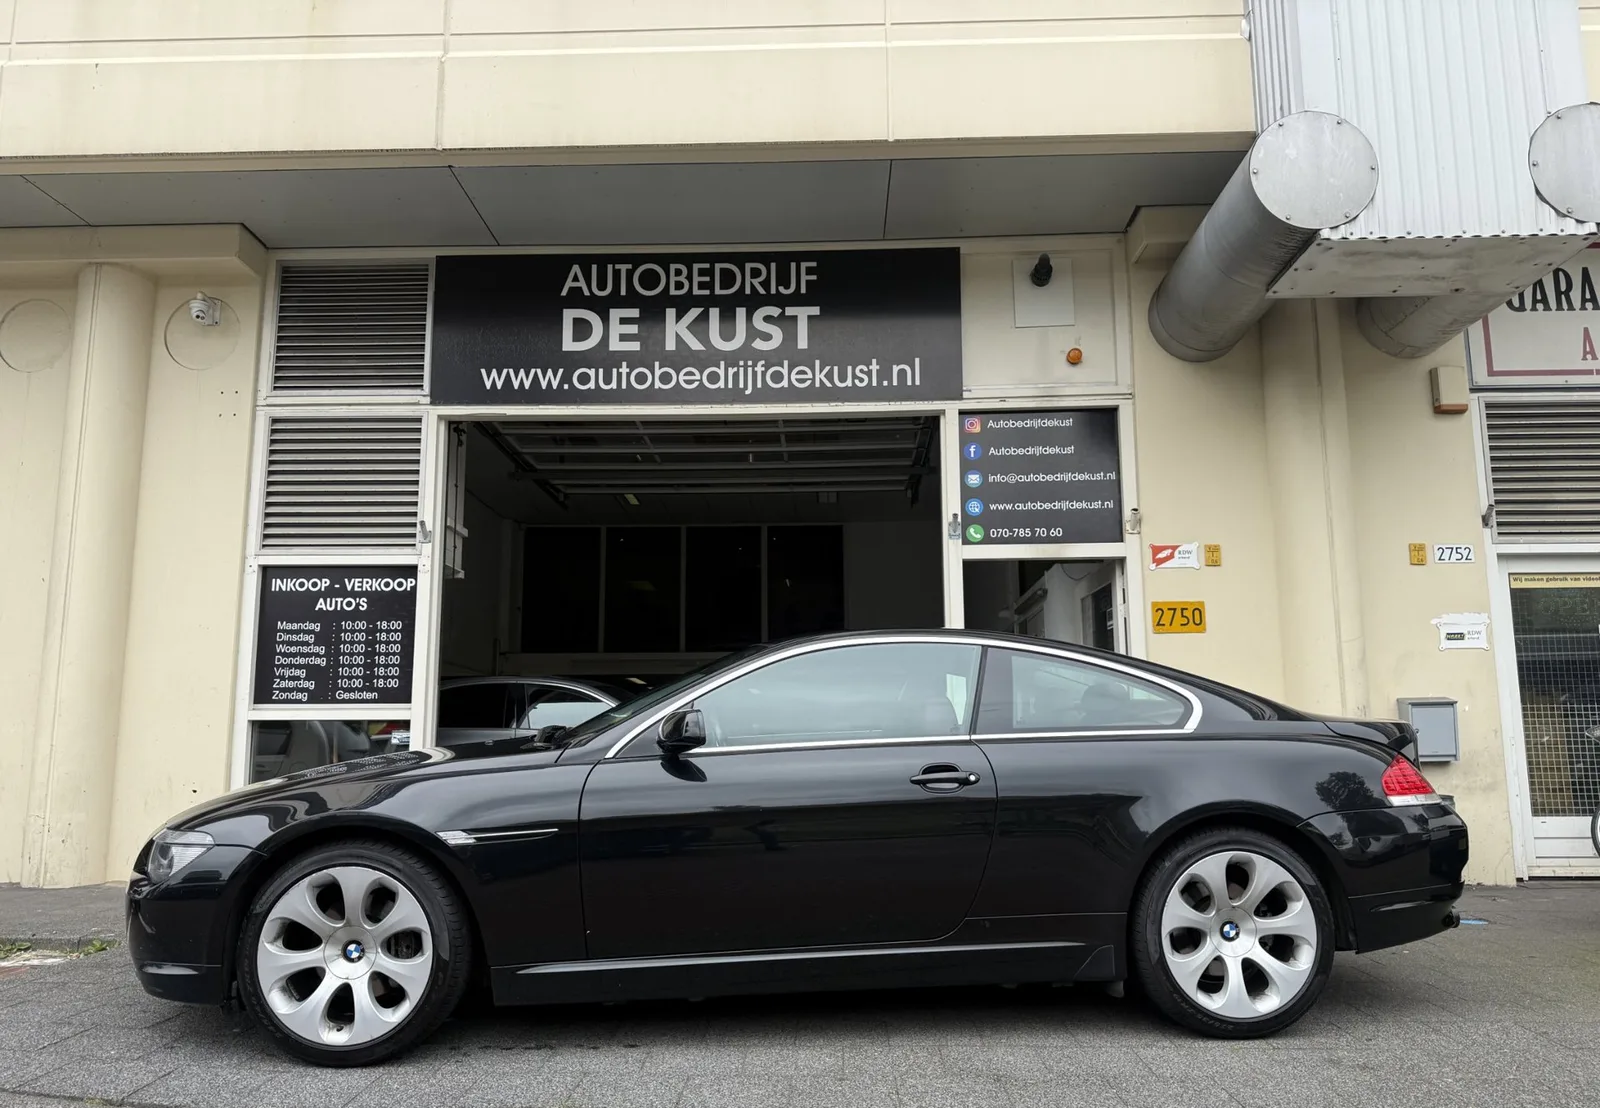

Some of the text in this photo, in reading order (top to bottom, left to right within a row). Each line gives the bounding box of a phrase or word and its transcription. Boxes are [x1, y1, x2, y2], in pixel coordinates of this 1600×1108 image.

[561, 262, 817, 296] AUTOBEDRIJF
[562, 306, 821, 352] DE KUST
[481, 358, 920, 395] www.autobedrijfdekust.nl
[986, 418, 1073, 429] Autobedrijfdekust
[988, 445, 1075, 457] Autobedrijfdekust
[988, 472, 1116, 484] info@autobedrijfdekust.nl
[988, 500, 1114, 511] www.autobedrijfdekust.nl
[989, 528, 1063, 538] 070-785 70 60
[1437, 546, 1473, 561] 2752
[271, 578, 331, 592] INKOOP
[345, 577, 416, 592] VERKOOP
[314, 598, 368, 611] AUTO'S
[1155, 607, 1203, 627] 2750
[277, 621, 321, 632] Maandag
[340, 621, 367, 630] 10:00
[375, 621, 403, 630] 18:00
[276, 632, 315, 643] Dinsdag
[340, 633, 367, 642] 10:00
[375, 632, 402, 642] 18:00
[275, 644, 326, 655] Woensdag
[339, 644, 366, 653] 10:00
[374, 644, 402, 653] 18:00
[274, 655, 327, 666] Donderdag
[338, 656, 365, 665] 10:00
[373, 656, 401, 665] 18:00
[274, 667, 307, 678] Vrijdag
[337, 667, 364, 677] 10:00
[373, 667, 400, 677] 18:00
[273, 679, 315, 689] Zaterdag
[336, 679, 364, 688] 10:00
[372, 679, 399, 688] 18:00
[272, 690, 308, 701] Zondag
[335, 690, 378, 700] Gesloten
